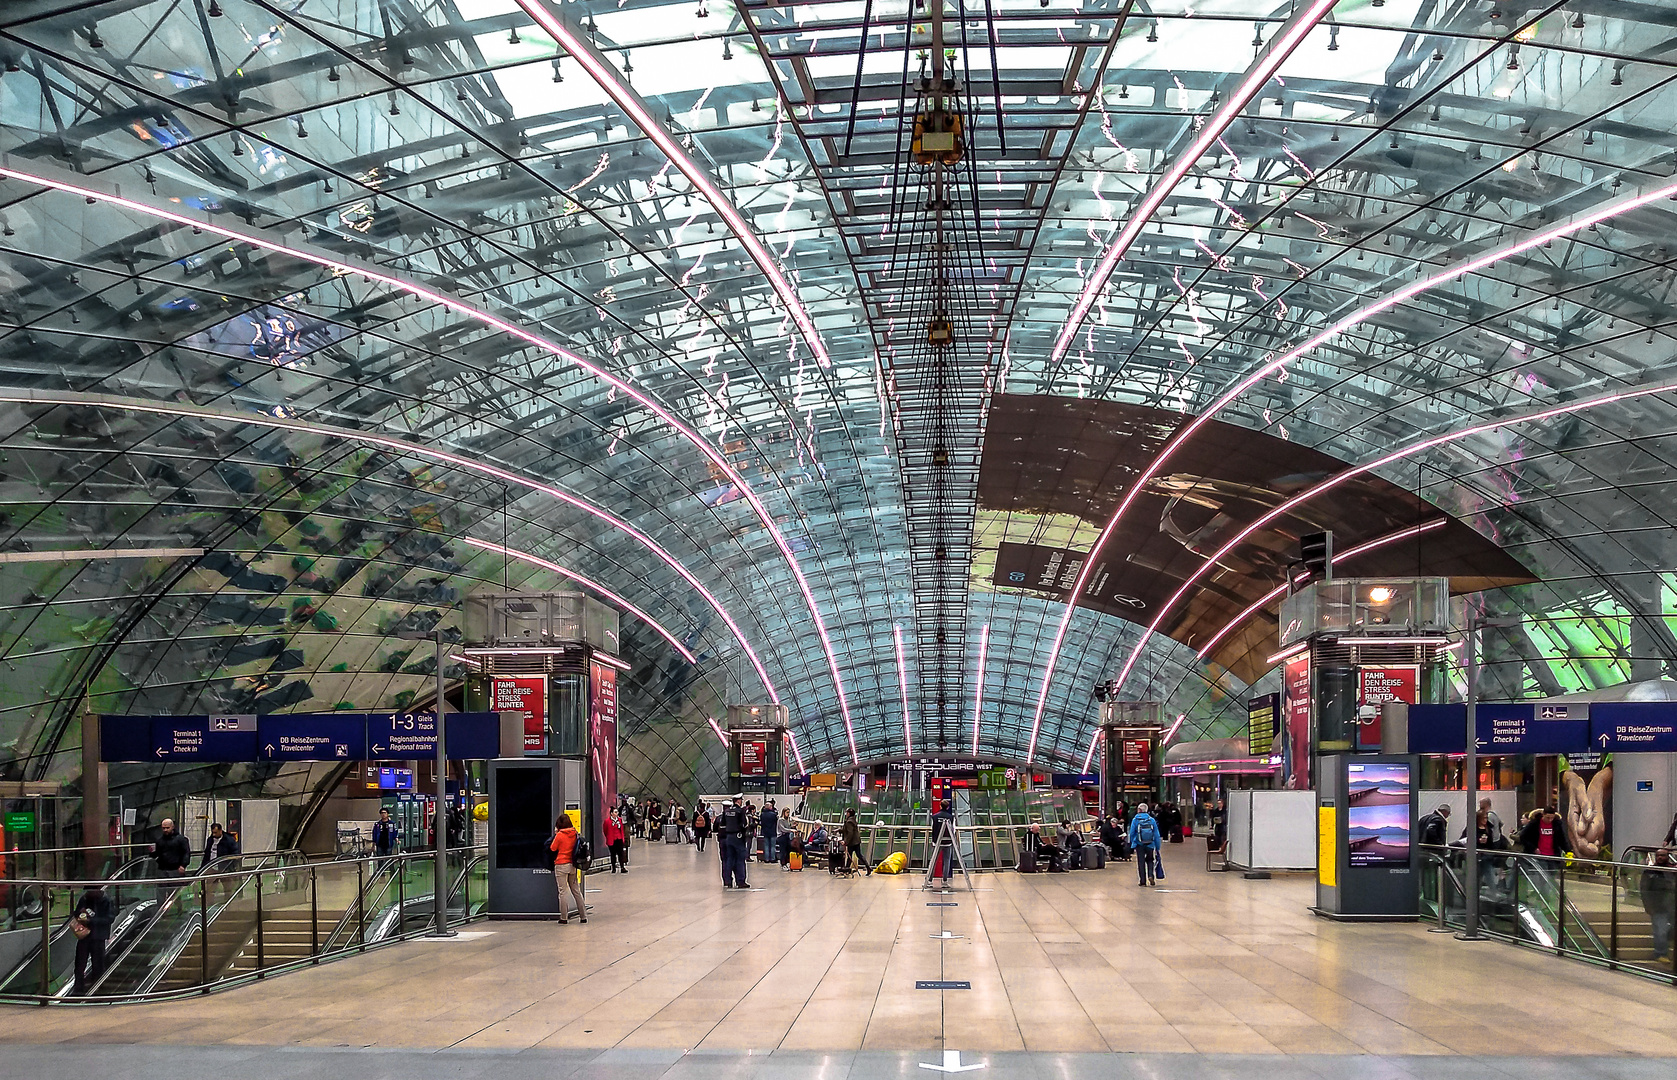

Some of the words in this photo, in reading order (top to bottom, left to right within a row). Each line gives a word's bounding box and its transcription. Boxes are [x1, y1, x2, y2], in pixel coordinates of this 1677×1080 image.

[1382, 679, 1404, 687] REISE-
[389, 714, 414, 730] 1-3
[1628, 725, 1672, 733] ReiseZentrum
[389, 735, 438, 744] Regionalbahnhof
[1617, 734, 1656, 742] Travelcenter
[389, 744, 415, 752] Regional
[915, 763, 974, 771] SQUAIRE
